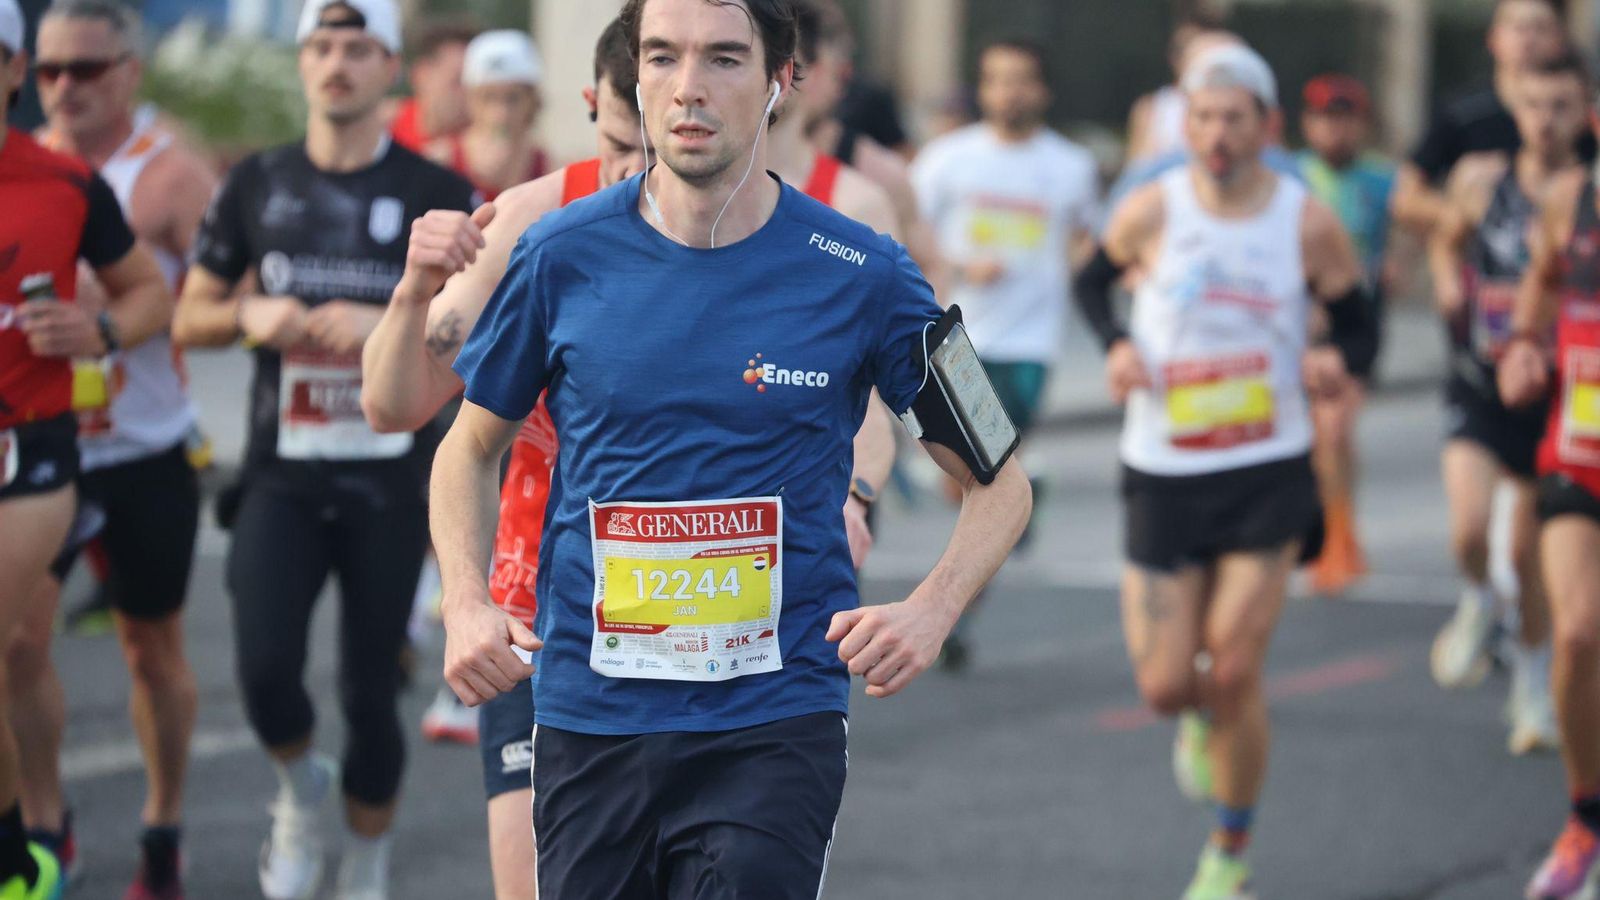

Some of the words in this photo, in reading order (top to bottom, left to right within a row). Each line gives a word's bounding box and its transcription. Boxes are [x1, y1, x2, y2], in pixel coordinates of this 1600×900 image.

[809, 233, 867, 266] FUSION
[762, 363, 830, 388] Eneco
[637, 508, 765, 538] GENERALI
[631, 566, 742, 600] 12244
[672, 605, 697, 616] JAN
[725, 634, 750, 649] 21K
[745, 652, 769, 664] renfe
